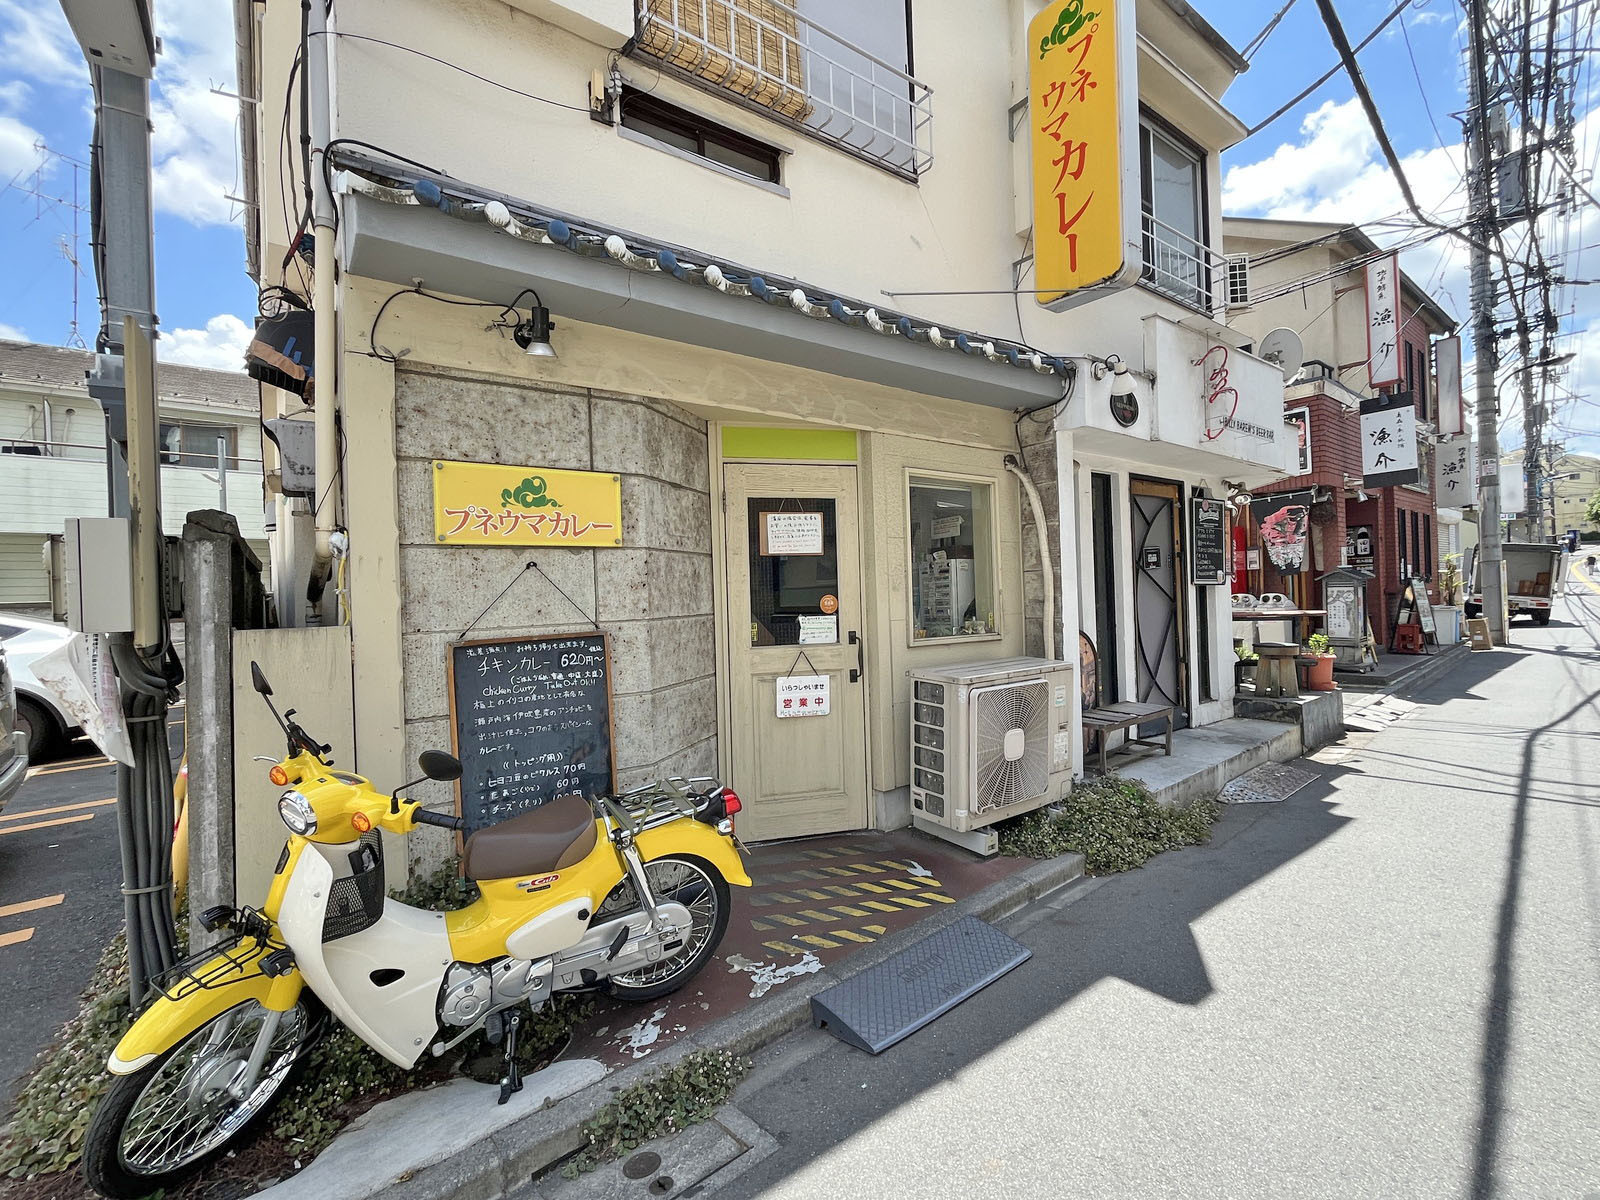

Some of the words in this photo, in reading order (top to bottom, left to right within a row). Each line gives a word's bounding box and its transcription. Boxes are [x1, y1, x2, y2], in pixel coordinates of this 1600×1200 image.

[1041, 23, 1098, 273] プネウマカレー
[1370, 427, 1397, 469] 漁介
[444, 505, 613, 538] プネウマカレー
[477, 656, 551, 676] チキンカレー
[482, 684, 511, 697] Chicken
[512, 684, 537, 695] Curry
[544, 681, 563, 690] Take
[783, 696, 824, 708] 営業中
[563, 763, 586, 774] 70円
[556, 777, 579, 788] 60円
